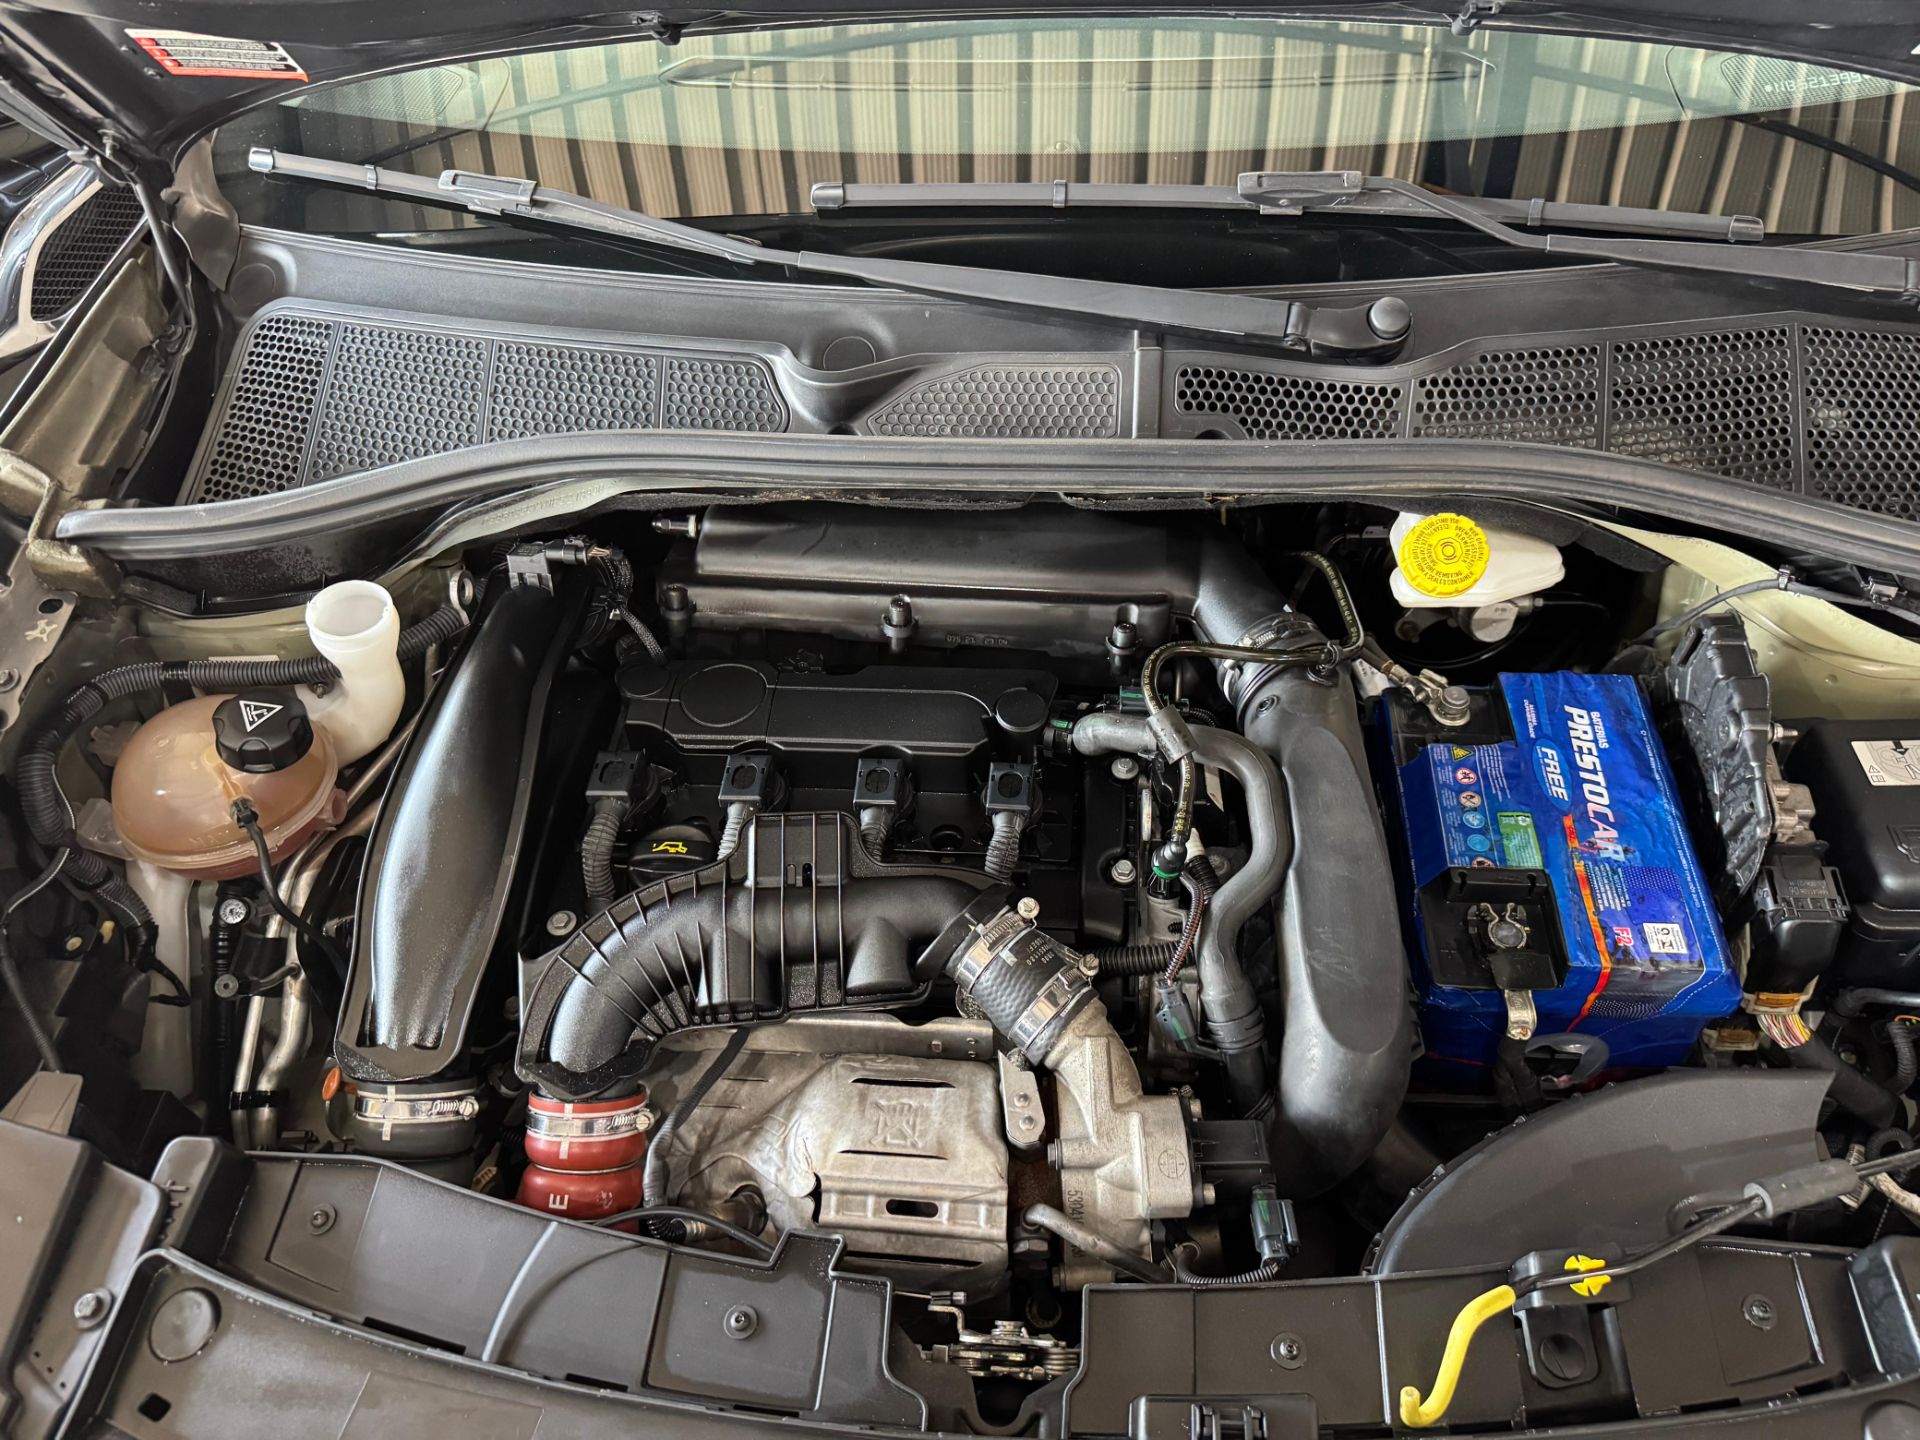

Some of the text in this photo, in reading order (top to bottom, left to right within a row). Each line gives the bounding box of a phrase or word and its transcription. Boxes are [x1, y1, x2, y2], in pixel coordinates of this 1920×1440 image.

[1589, 711, 1610, 749] BATERIAS
[1541, 746, 1568, 802] FREE
[1563, 704, 1626, 863] PRESTOCAR
